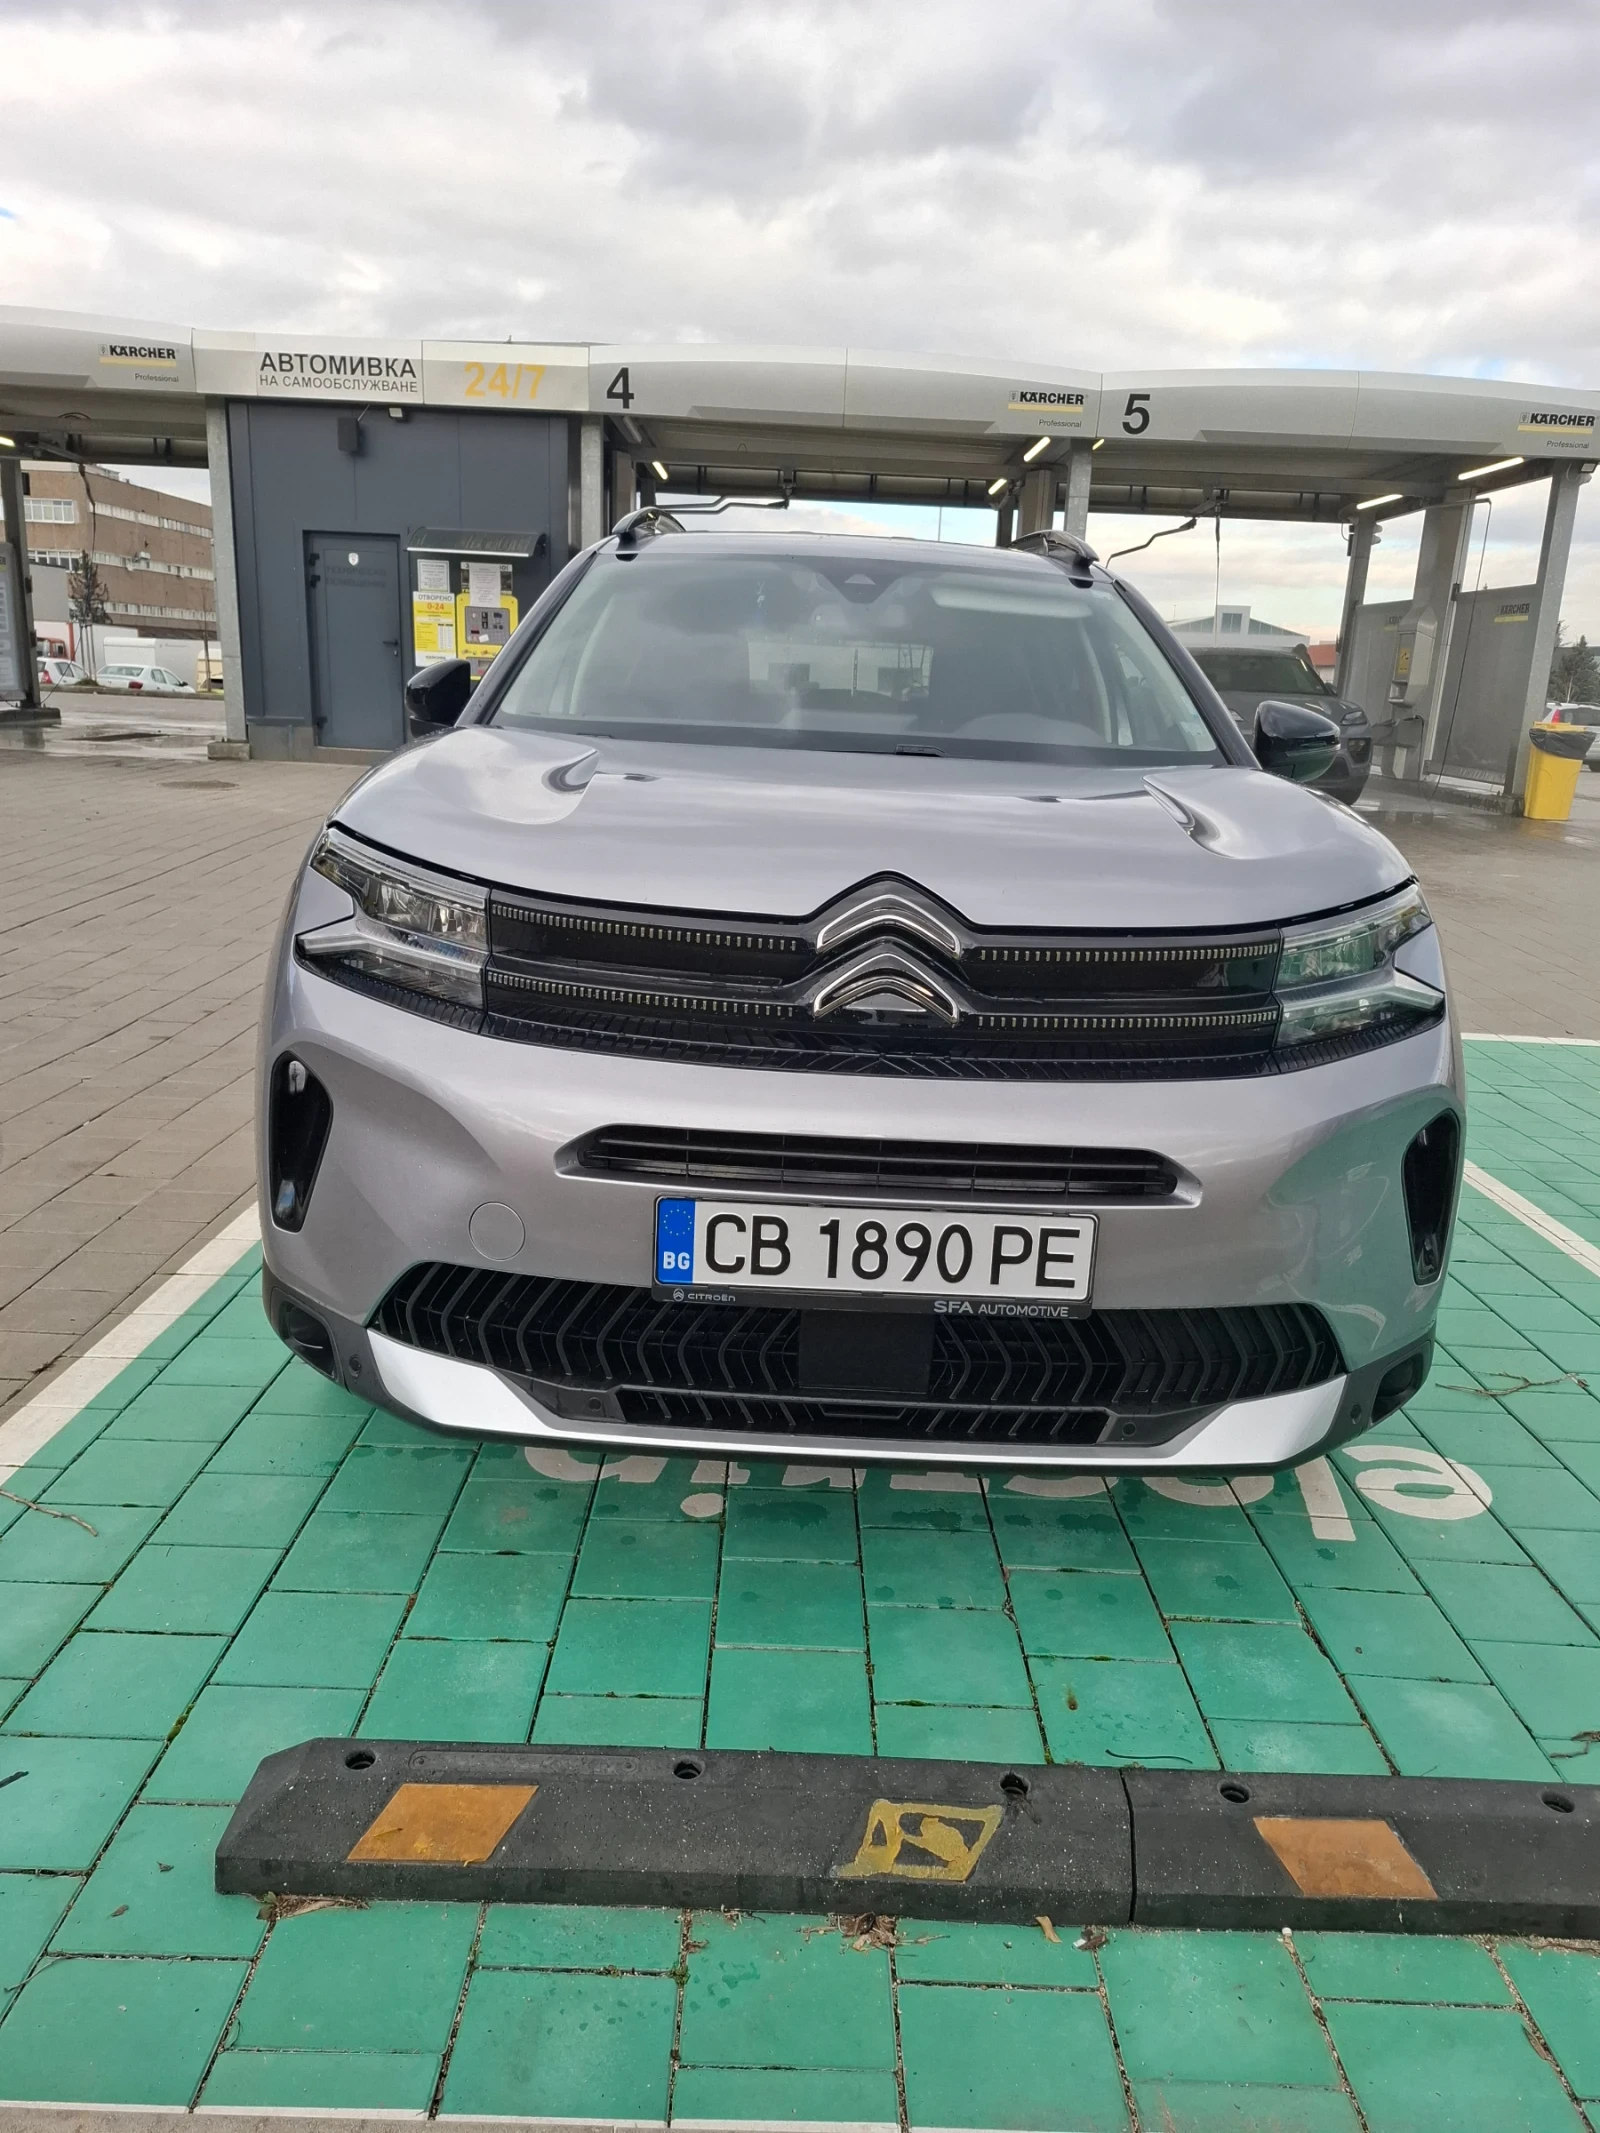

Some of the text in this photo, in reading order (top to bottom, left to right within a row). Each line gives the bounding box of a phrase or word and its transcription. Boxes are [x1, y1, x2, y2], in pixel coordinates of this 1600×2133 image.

[109, 344, 176, 359] KÄRCHER
[260, 352, 417, 378] АВТОМИВКА
[134, 372, 179, 383] Professional
[260, 374, 418, 393] НА САМООБСЛУЖВАНЕ
[464, 361, 546, 399] 24/7
[606, 367, 635, 409] 4
[1019, 391, 1084, 405] KÄRCHER
[1121, 393, 1151, 435] 5
[1529, 412, 1596, 427] KÄRCHER
[1038, 419, 1082, 428] Professional
[1546, 440, 1590, 449] Professional
[418, 594, 453, 602] ОТВОРЕНО
[705, 1213, 1081, 1288] CB 1890 PE
[663, 1251, 690, 1270] BG
[933, 1300, 1069, 1318] SFA AUTOMOTIVE
